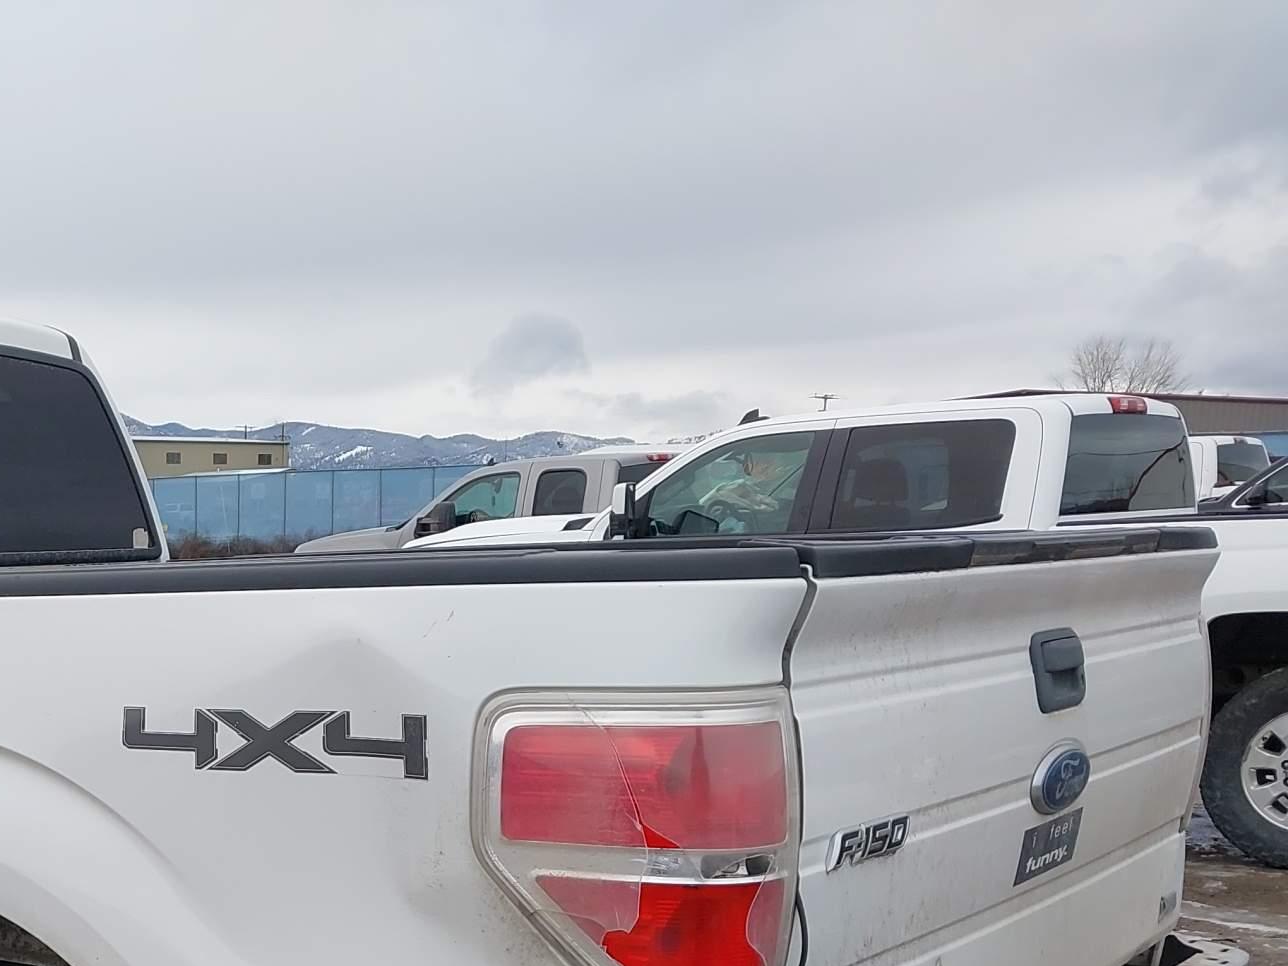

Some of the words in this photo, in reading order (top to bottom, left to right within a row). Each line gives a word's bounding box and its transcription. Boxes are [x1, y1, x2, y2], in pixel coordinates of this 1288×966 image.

[829, 814, 911, 870] F-150
[1049, 816, 1074, 841] feel
[1025, 844, 1068, 873] funny.
